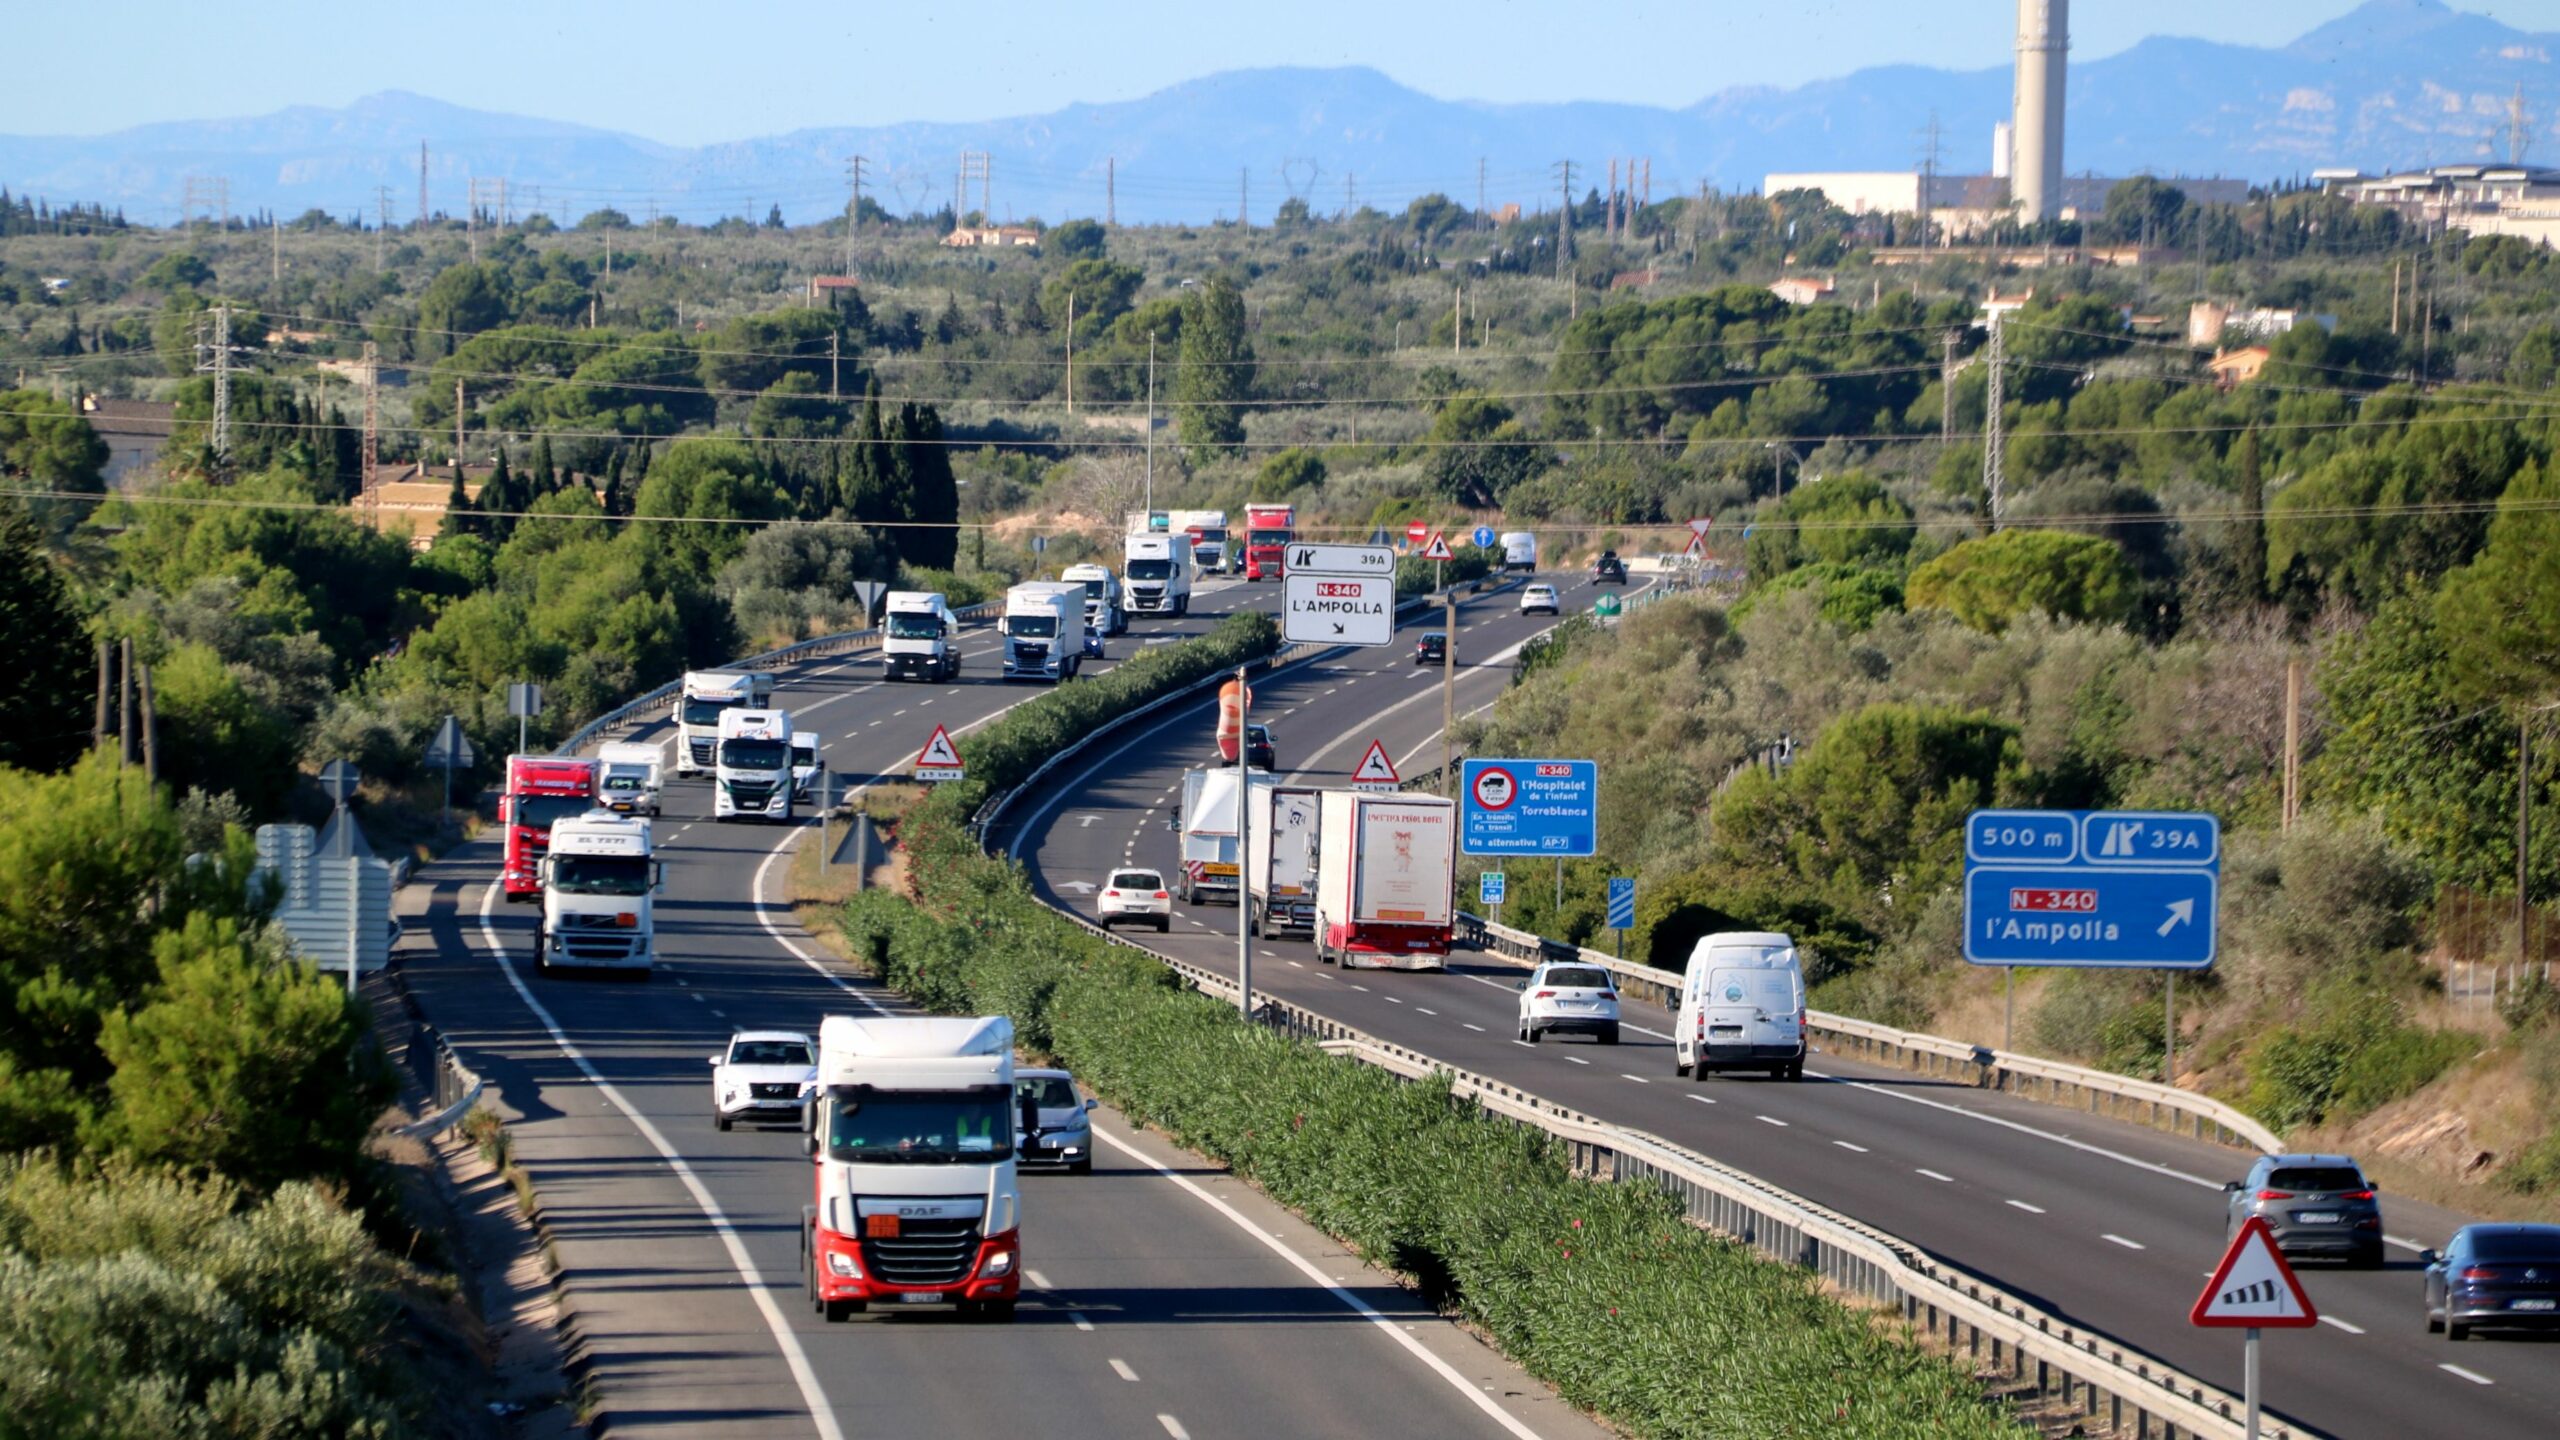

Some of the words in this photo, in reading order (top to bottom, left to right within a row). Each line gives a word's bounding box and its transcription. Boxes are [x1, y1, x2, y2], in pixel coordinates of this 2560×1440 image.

[1361, 554, 1385, 565] 39A
[1292, 600, 1384, 615] L'AMPOLLA
[1521, 780, 1587, 792] l'Hospitalet
[1529, 791, 1541, 801] de
[1520, 805, 1588, 817] Torreblanca
[1487, 837, 1537, 847] alternativa
[1544, 837, 1567, 847] AP-7
[1983, 828, 2036, 847] 500
[2044, 831, 2063, 847] m
[2150, 830, 2200, 849] 39A
[1612, 880, 1631, 888] 300
[2012, 891, 2095, 910] N-340
[1986, 917, 2119, 945] l'Ampolla
[898, 1207, 944, 1216] DAF
